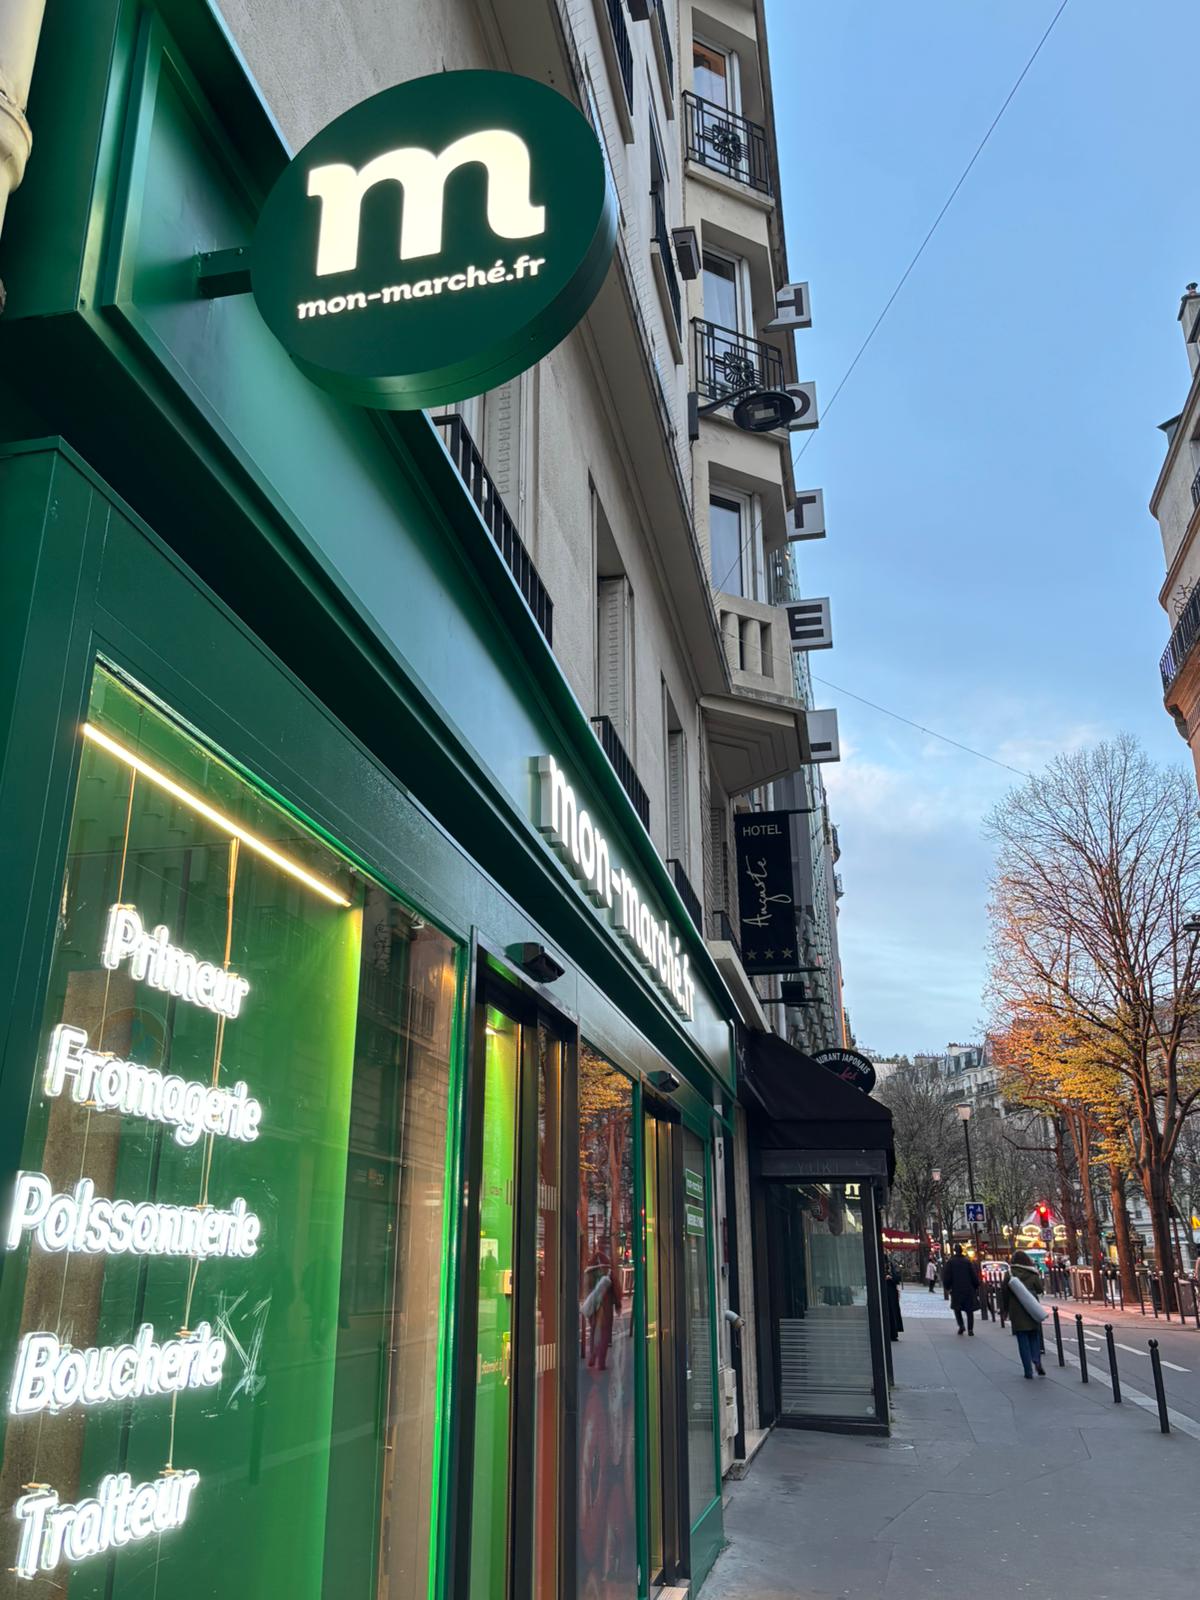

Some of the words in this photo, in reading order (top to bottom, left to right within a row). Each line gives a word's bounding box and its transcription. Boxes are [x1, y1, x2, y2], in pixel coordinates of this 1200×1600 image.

[306, 129, 546, 277] m
[297, 254, 546, 320] mon-marché.fr
[743, 824, 782, 837] HOTEL
[532, 754, 695, 1022] mon-marché.fr
[742, 855, 792, 928] Auguste
[103, 903, 250, 1019] Primeur
[44, 1023, 263, 1147] Fromagerie
[842, 1053, 871, 1075] JAPONAIS
[6, 1170, 261, 1260] Poissonnerie
[9, 1321, 227, 1415] Boucherie
[16, 1469, 201, 1580] Traiteur
